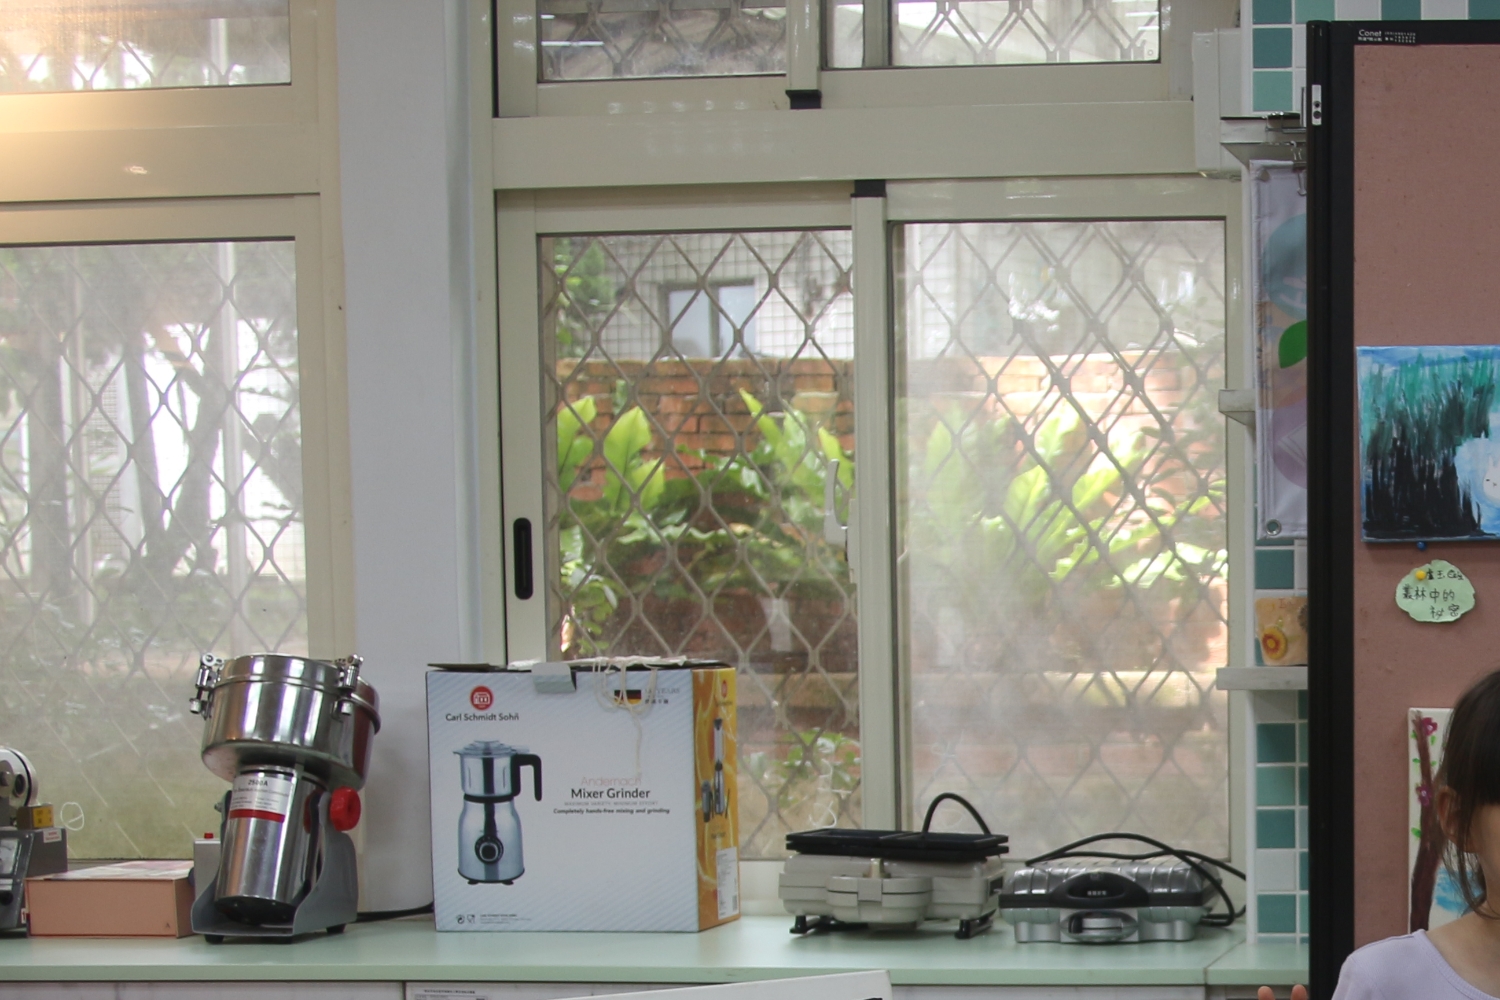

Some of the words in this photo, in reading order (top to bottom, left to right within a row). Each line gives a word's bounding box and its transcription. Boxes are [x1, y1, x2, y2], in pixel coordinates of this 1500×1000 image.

[445, 713, 461, 722] Carl
[463, 712, 497, 722] Schmidt
[570, 787, 603, 799] Mixer
[607, 787, 651, 799] Grinder
